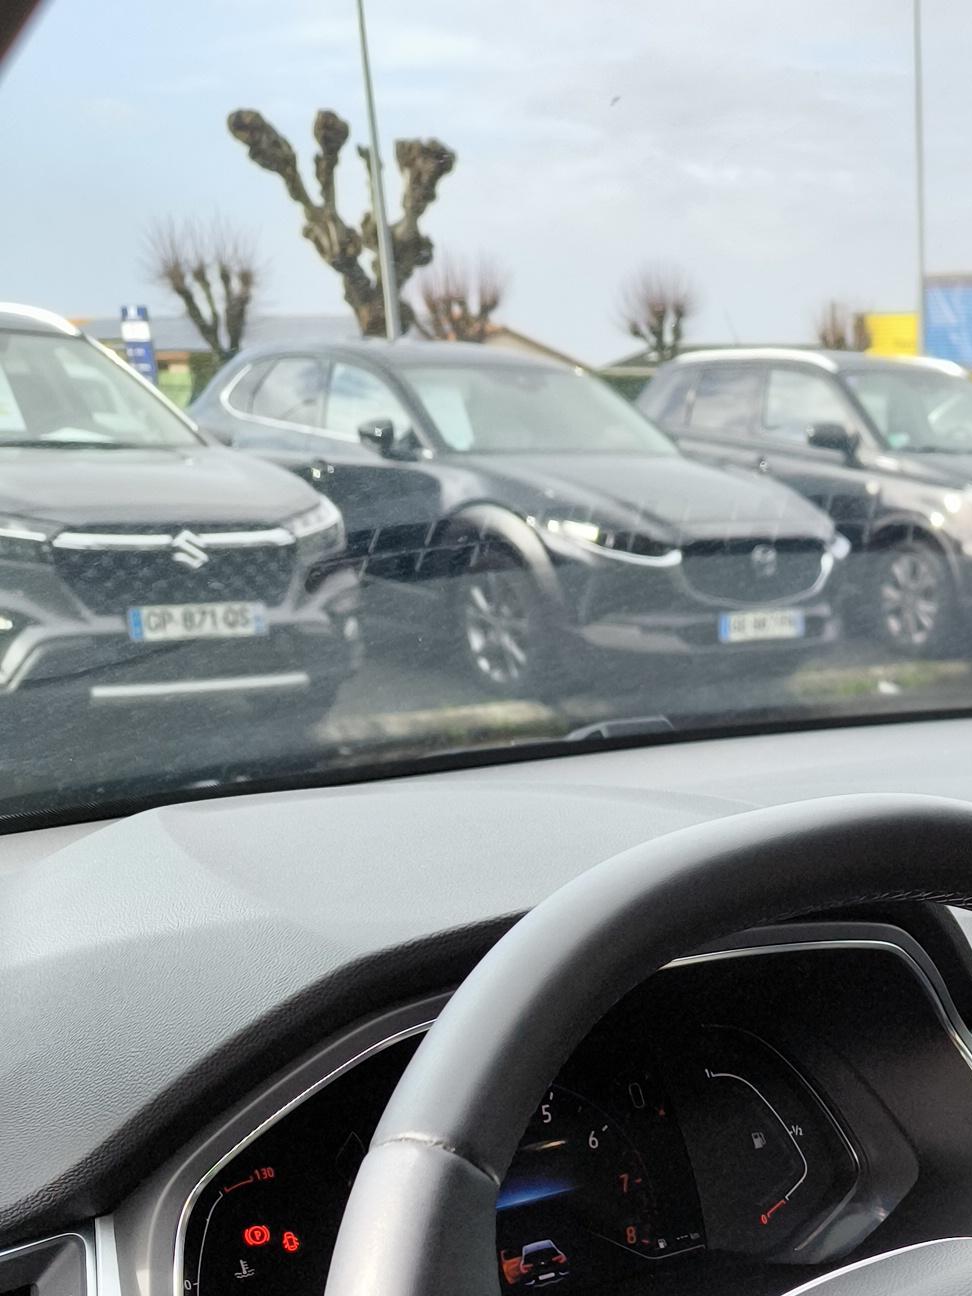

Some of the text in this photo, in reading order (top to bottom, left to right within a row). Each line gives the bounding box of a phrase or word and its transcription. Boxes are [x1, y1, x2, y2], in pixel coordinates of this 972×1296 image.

[542, 1104, 552, 1124] 5
[588, 1130, 599, 1149] 6
[254, 1166, 275, 1181] 130
[619, 1173, 630, 1194] 7
[625, 1225, 638, 1245] 8
